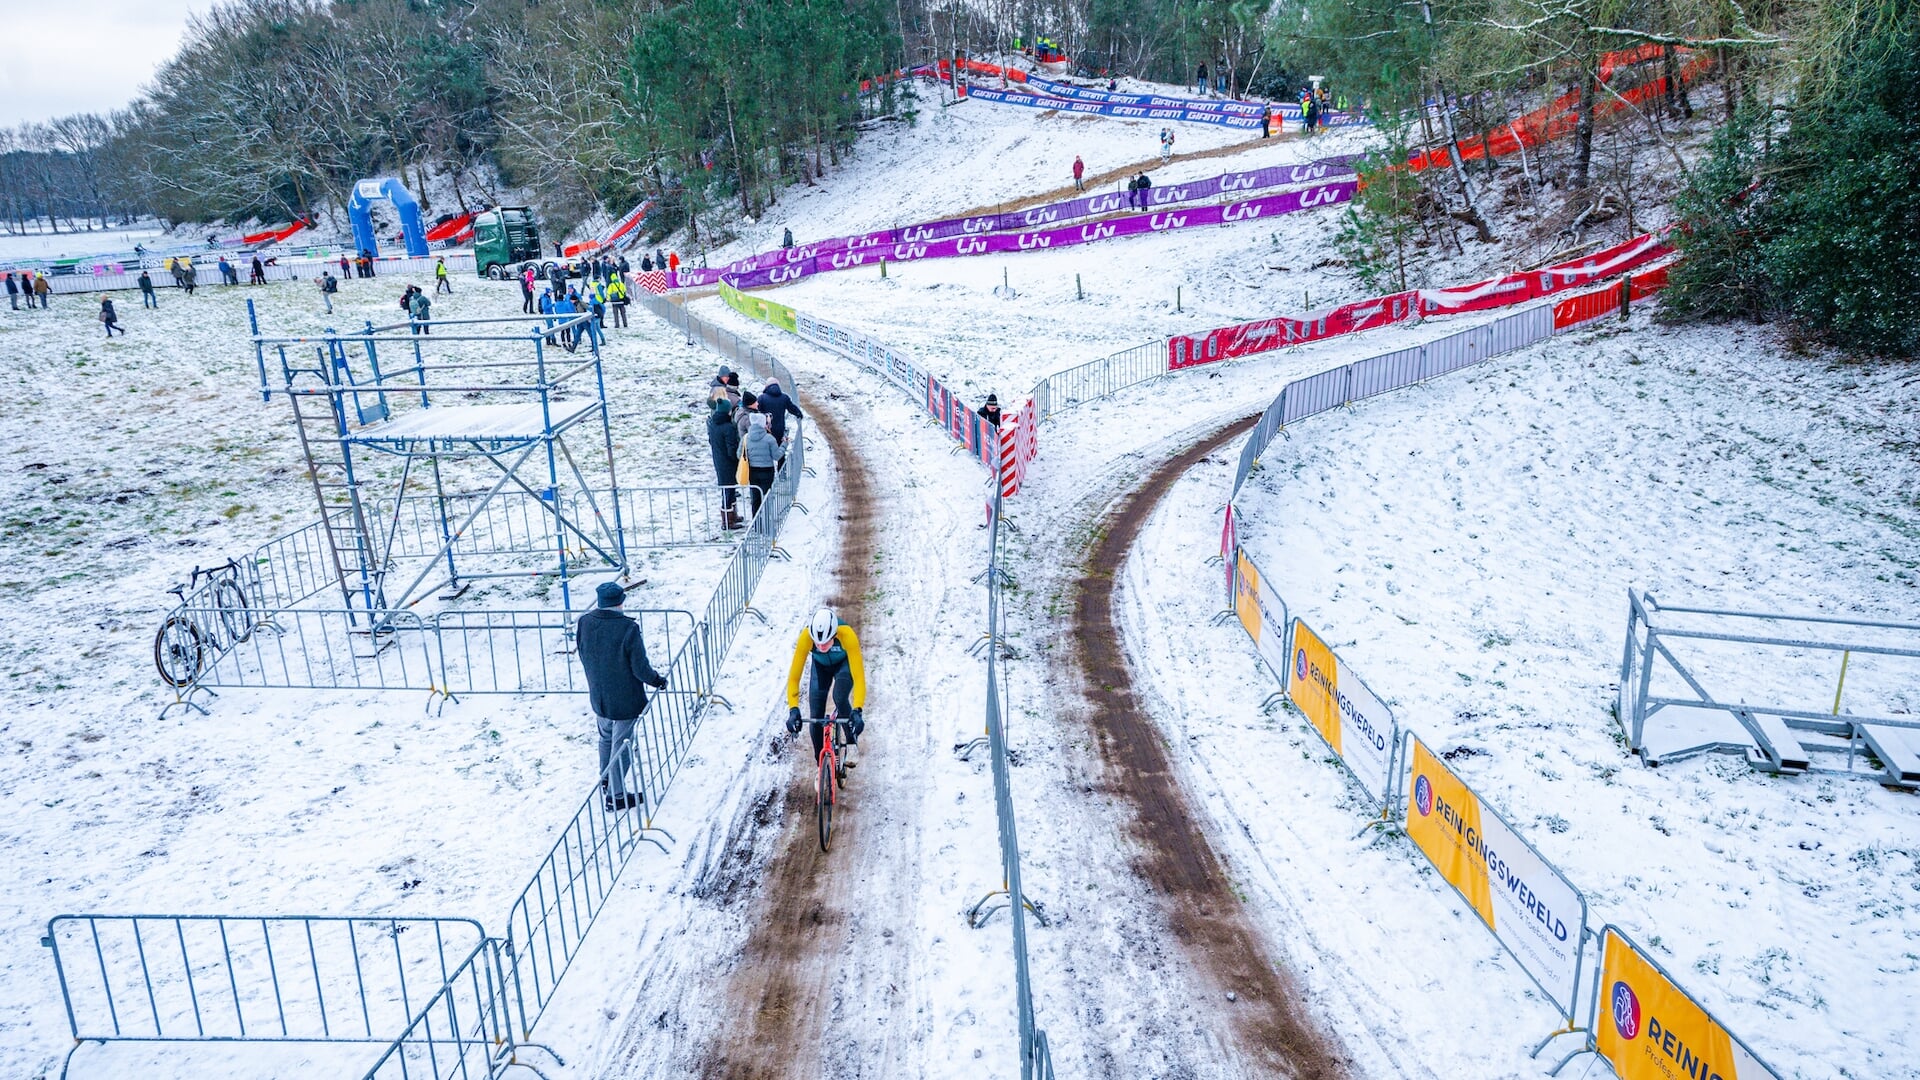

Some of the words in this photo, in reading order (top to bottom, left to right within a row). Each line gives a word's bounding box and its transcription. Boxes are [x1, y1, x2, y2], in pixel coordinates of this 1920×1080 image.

[972, 89, 1002, 100] GIANT
[1005, 94, 1033, 104] GIANT
[1036, 98, 1069, 109] GIANT
[1072, 103, 1103, 112] GIANT
[1149, 109, 1183, 119] GIANT
[1186, 111, 1223, 122] GIANT
[1226, 115, 1260, 127] GIANT
[1050, 85, 1077, 95] GIANT
[1079, 90, 1107, 101] GIANT
[1108, 94, 1141, 105] GIANT
[1151, 97, 1183, 108] GIANT
[1186, 102, 1220, 112] GIANT
[1222, 103, 1261, 115] GIANT
[769, 265, 802, 283] Liv
[831, 250, 865, 268] Liv
[895, 242, 927, 260] Liv
[956, 237, 987, 254] Liv
[1018, 233, 1051, 249] Liv
[1081, 222, 1116, 241] Liv
[1150, 212, 1187, 230] Liv
[1222, 202, 1262, 221] Liv
[1300, 186, 1340, 208] Liv
[785, 245, 817, 263] Liv
[847, 235, 879, 249] Liv
[903, 225, 934, 242] Liv
[963, 217, 994, 233] Liv
[1025, 207, 1057, 224] Liv
[1088, 195, 1121, 213] Liv
[1153, 186, 1188, 203] Liv
[1220, 173, 1256, 191] Liv
[1290, 163, 1327, 182] Liv
[1310, 662, 1385, 752] REINIGINGSWERELD
[1436, 796, 1568, 942] REINIGINGSWERELD
